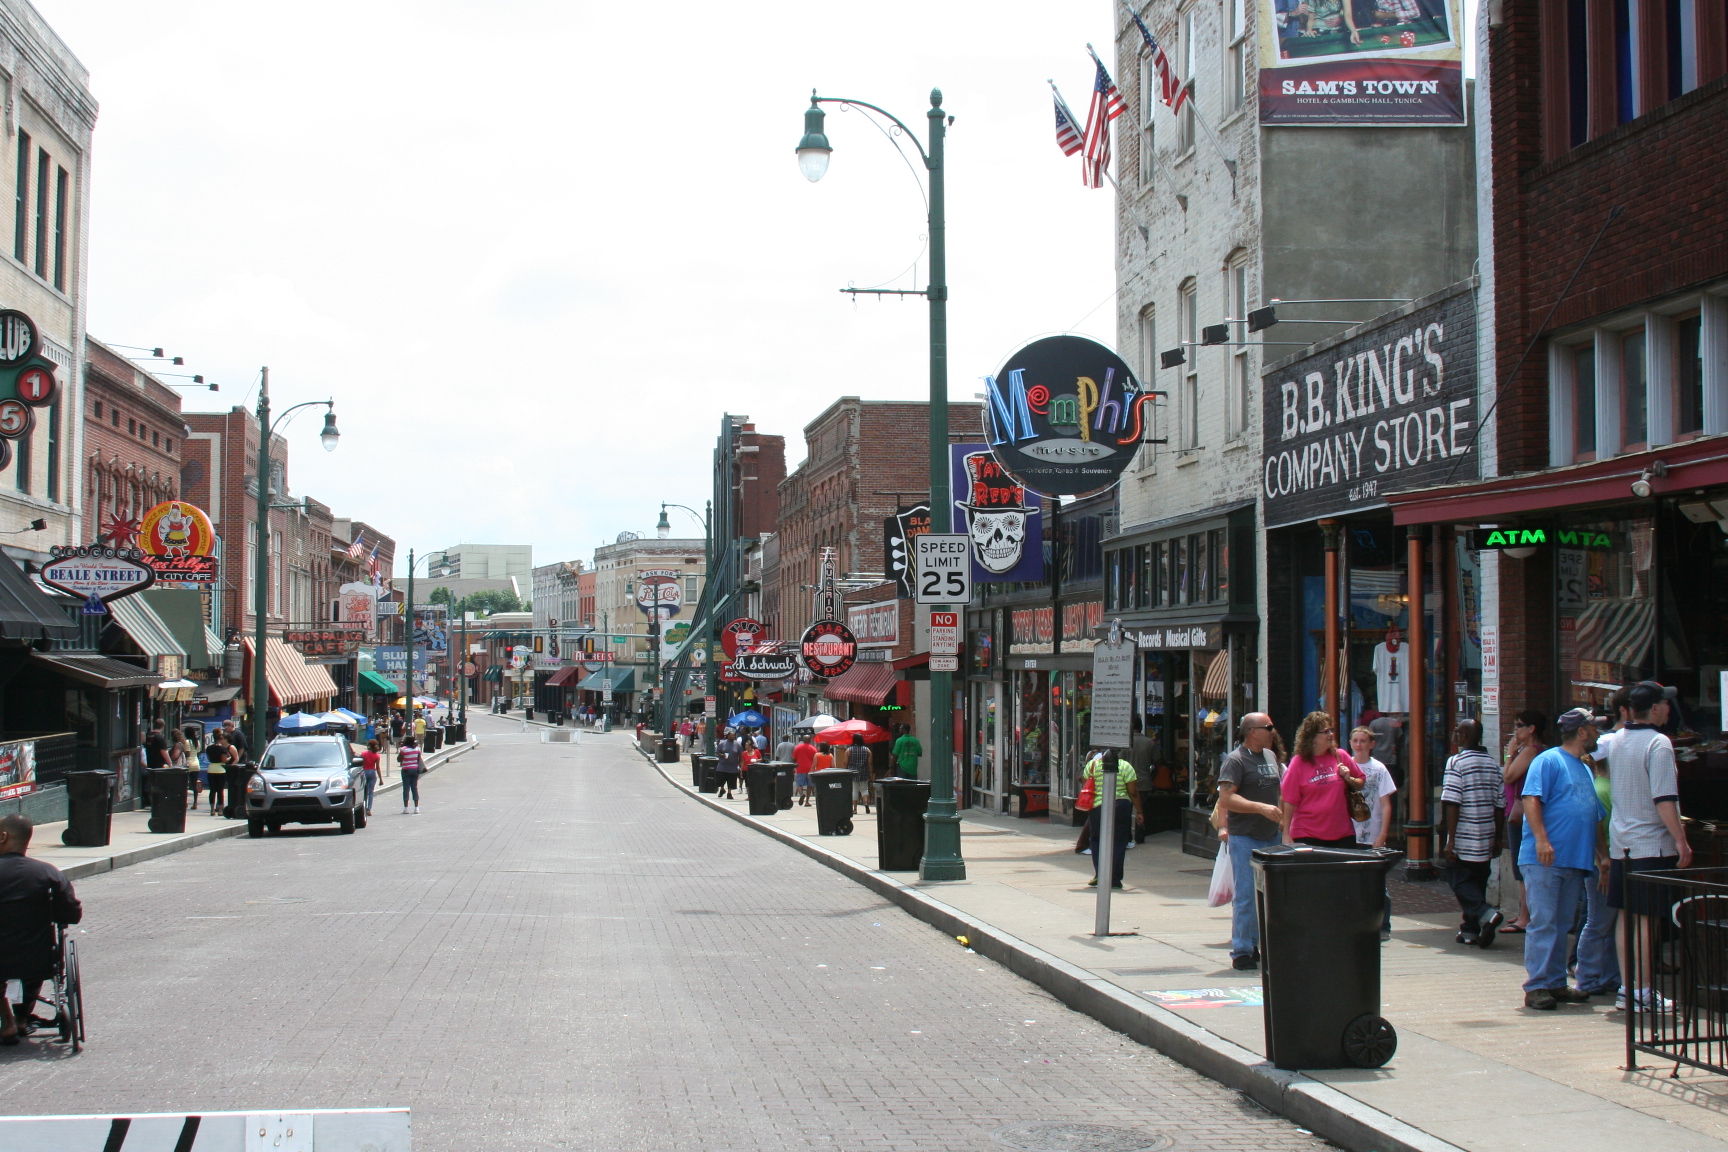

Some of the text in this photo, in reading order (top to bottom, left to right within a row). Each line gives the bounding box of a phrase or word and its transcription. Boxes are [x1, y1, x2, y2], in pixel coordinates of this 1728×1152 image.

[1281, 79, 1439, 96] SAM'S TOWN
[1296, 97, 1423, 106] HOTEL & GAMBLING HALL, TUNICA
[26, 372, 41, 398] 1
[1280, 322, 1444, 442] B.B. KING'S
[978, 366, 1157, 446] Memphis
[0, 405, 21, 431] 5
[1264, 398, 1472, 499] COMPANY STORE
[970, 456, 1012, 481] TAT
[975, 482, 1024, 507] RED'S
[1362, 480, 1378, 498] 1947
[909, 516, 931, 526] BLA
[907, 525, 931, 538] DIAM
[1486, 529, 1546, 546] ATM
[51, 546, 141, 558] WELCOME
[920, 542, 966, 553] SPEED
[925, 556, 961, 568] LIMIT
[50, 568, 91, 580] BEALE
[94, 569, 143, 582] STREET
[163, 573, 185, 581] CITY
[186, 573, 212, 581] CAFE
[921, 570, 966, 597] 25
[935, 614, 953, 625] NO
[727, 620, 762, 634] PIG
[816, 624, 843, 635] BAR
[932, 627, 955, 635] PARKING
[288, 631, 363, 642] KING'S PALACE
[1138, 629, 1162, 648] Records
[1165, 627, 1190, 647] Musical
[1191, 626, 1207, 647] Gifts
[304, 642, 347, 654] CAFE
[803, 642, 855, 657] RESTAURANT
[382, 651, 420, 660] BLUS
[1488, 655, 1496, 667] AM
[386, 661, 416, 670] HAL
[749, 656, 796, 671] Schwab
[807, 657, 853, 676] 159 BEALE
